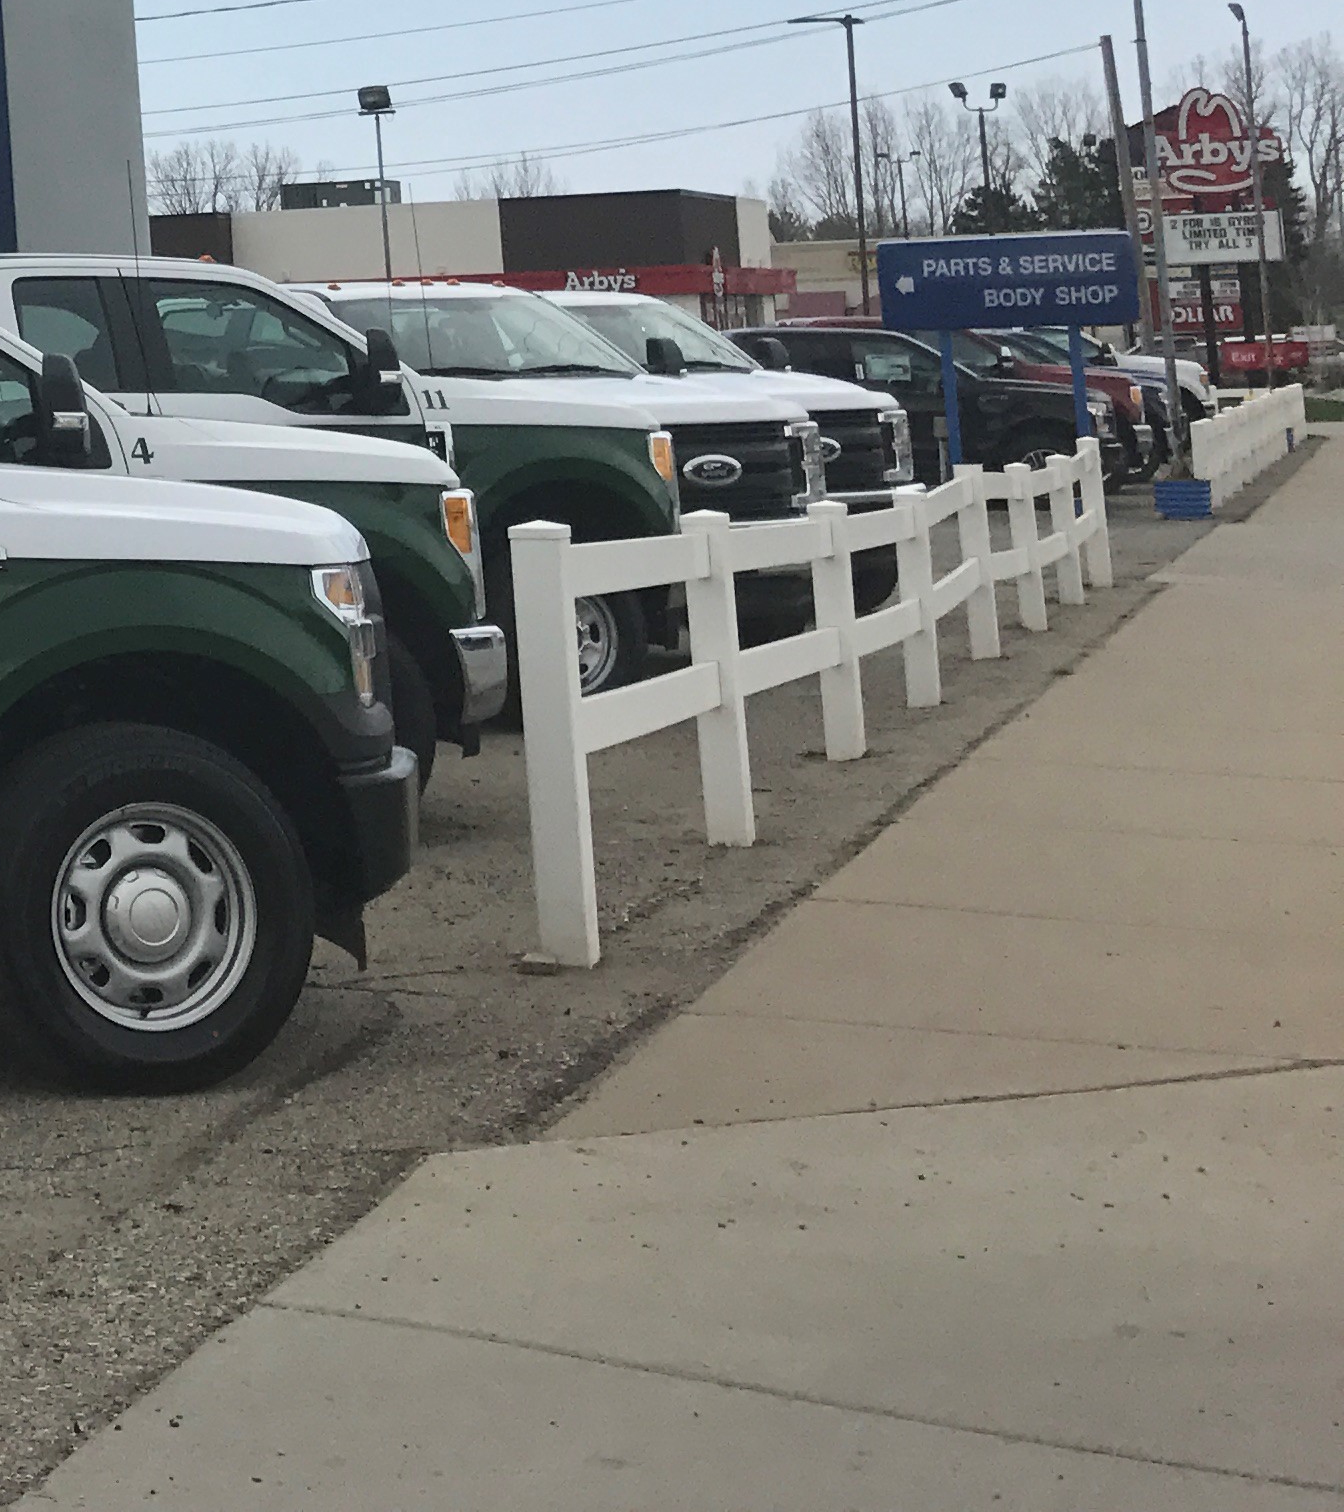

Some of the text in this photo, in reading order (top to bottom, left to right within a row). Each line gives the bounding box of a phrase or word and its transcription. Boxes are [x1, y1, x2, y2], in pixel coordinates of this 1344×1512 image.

[1182, 218, 1204, 229] FOR
[1182, 228, 1228, 240] LIMITED
[1218, 239, 1240, 249] ALL
[922, 252, 1117, 278] PARTS & SERVICE
[565, 268, 635, 292] Arby's
[984, 285, 1119, 308] BODY SHOP
[421, 389, 451, 410] 11
[131, 437, 155, 465] 4
